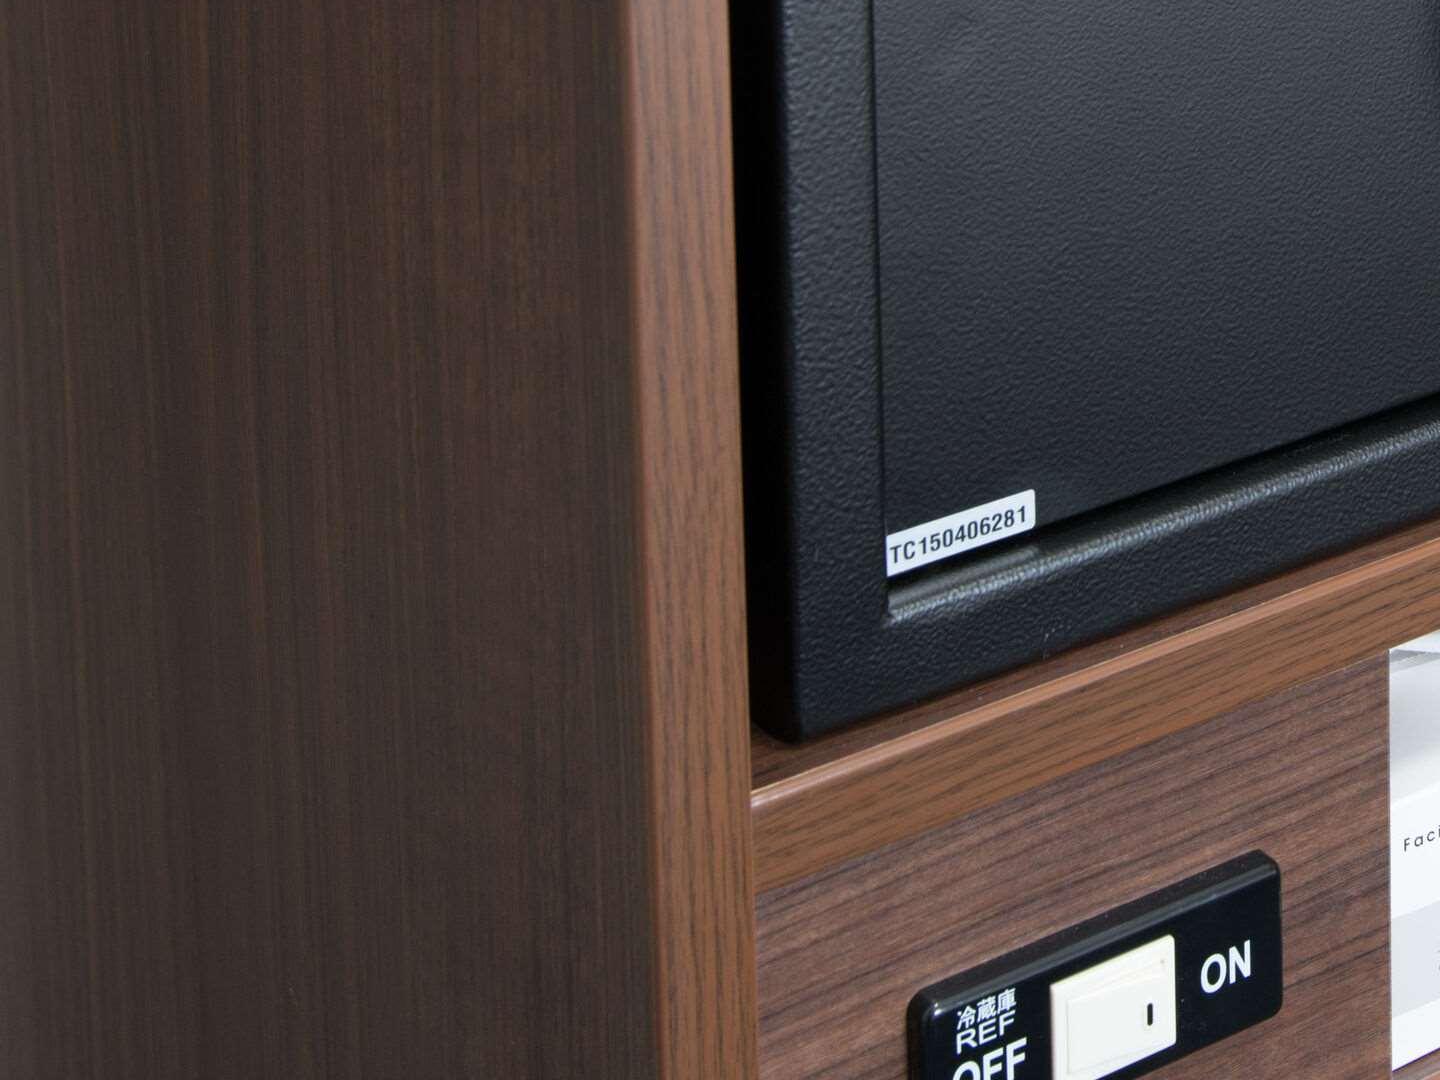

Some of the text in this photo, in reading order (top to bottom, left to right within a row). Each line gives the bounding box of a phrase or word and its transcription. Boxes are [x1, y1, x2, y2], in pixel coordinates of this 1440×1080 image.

[889, 505, 1026, 564] TC150406281
[1200, 939, 1252, 994] ON
[956, 987, 1017, 1030] 冷蔵庫
[956, 1009, 1017, 1055] REF
